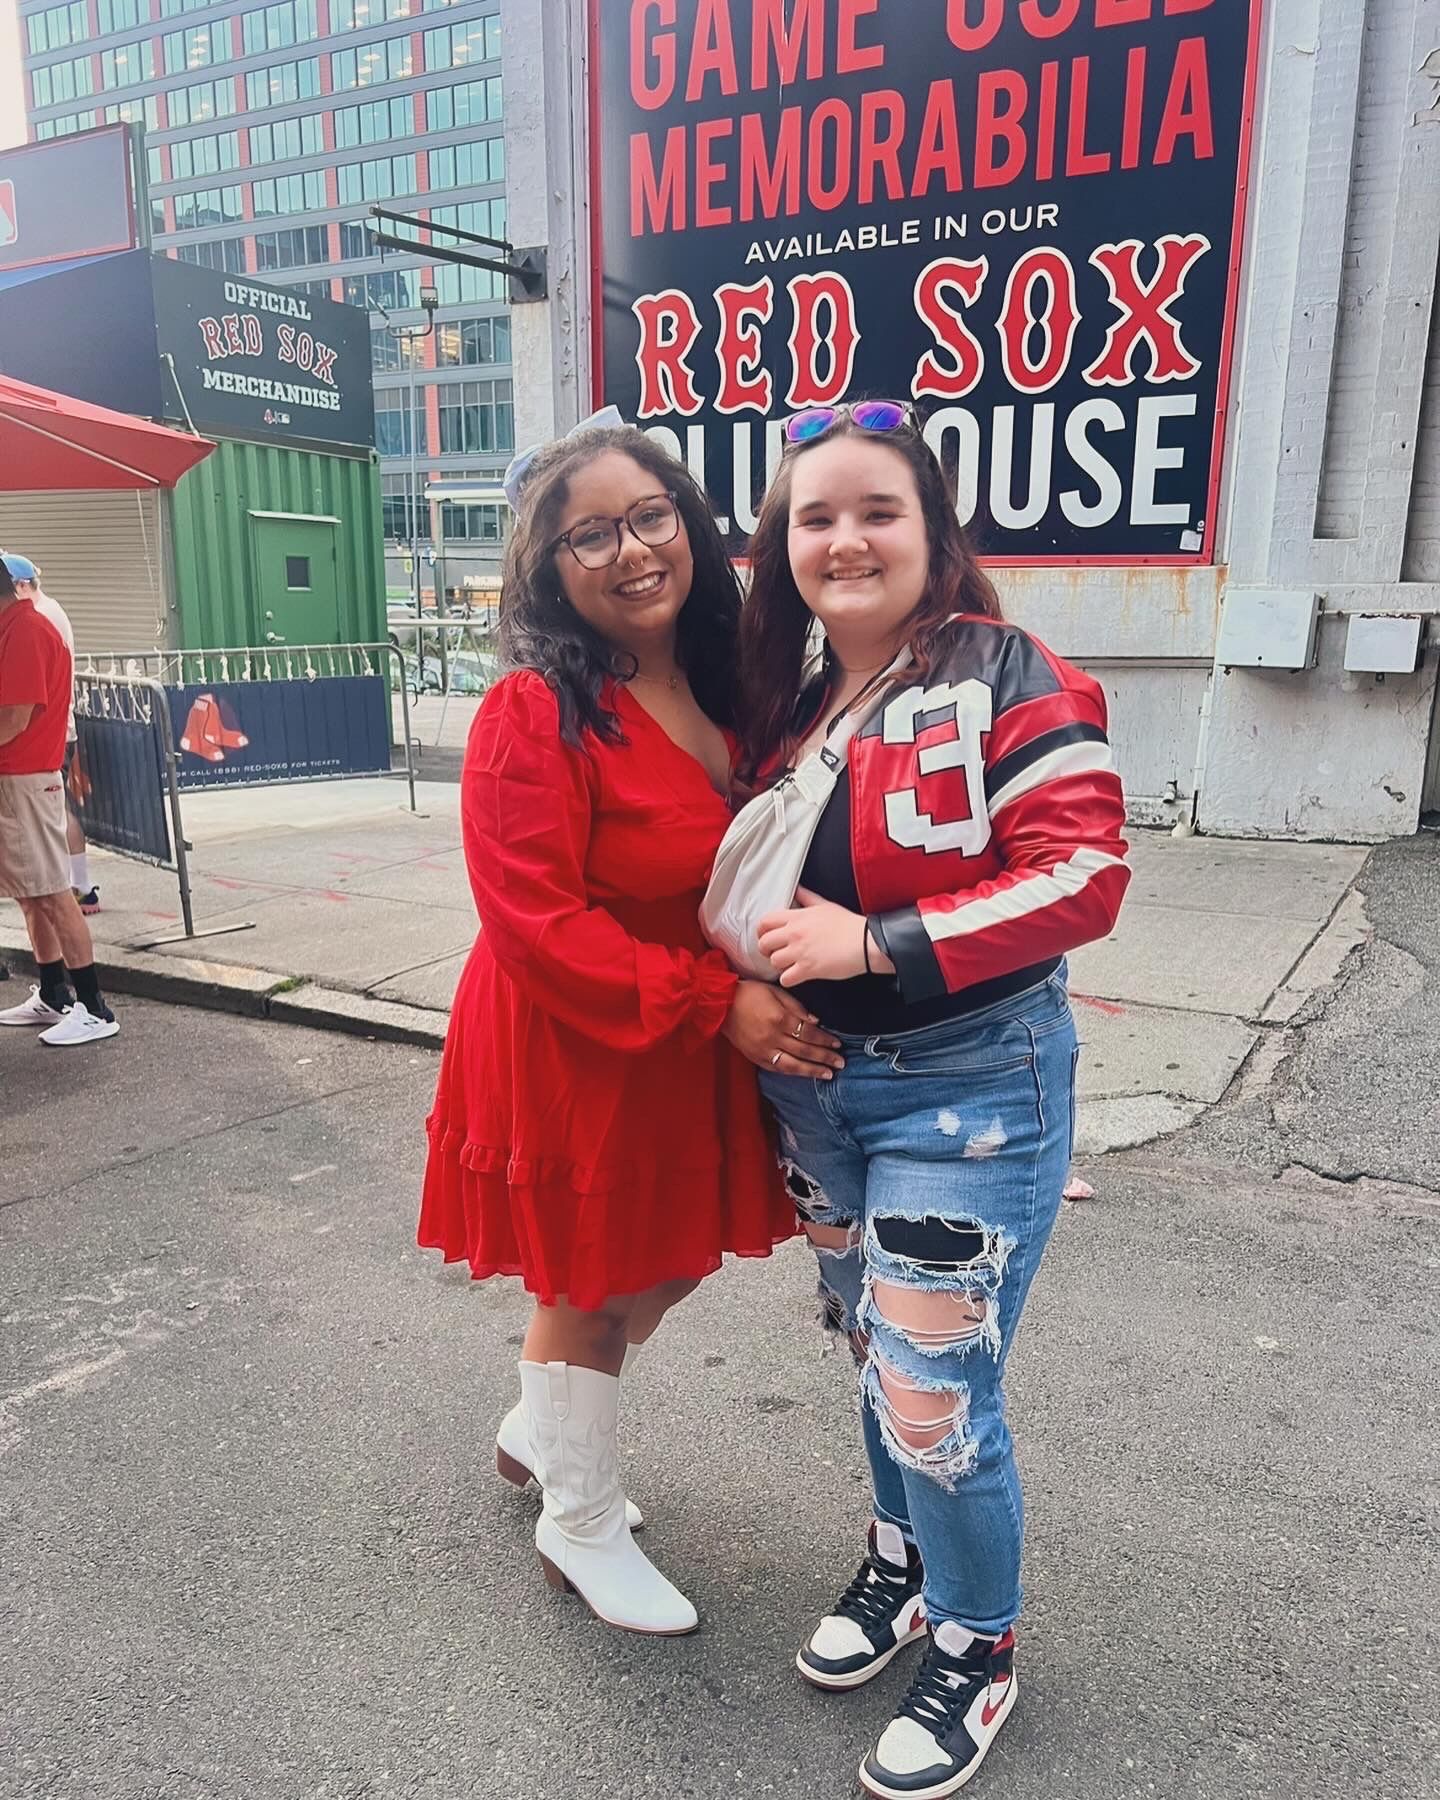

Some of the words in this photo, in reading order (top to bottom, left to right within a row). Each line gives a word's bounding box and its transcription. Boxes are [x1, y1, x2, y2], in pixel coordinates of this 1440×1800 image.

[630, 0, 885, 110] GAME
[629, 37, 1215, 237] MEMORABILIA
[744, 219, 921, 265] AVAILABLE
[934, 213, 968, 241] IN
[981, 203, 1060, 236] OUR
[224, 281, 312, 321] OFFICIAL
[632, 270, 862, 420] RED
[911, 233, 1213, 400] SOX
[198, 312, 263, 360] RED
[277, 323, 338, 385] SOX
[202, 368, 341, 411] MERCHANDISE
[643, 394, 1198, 536] LUOUSE
[190, 769, 211, 777] CALL
[882, 678, 993, 858] 3
